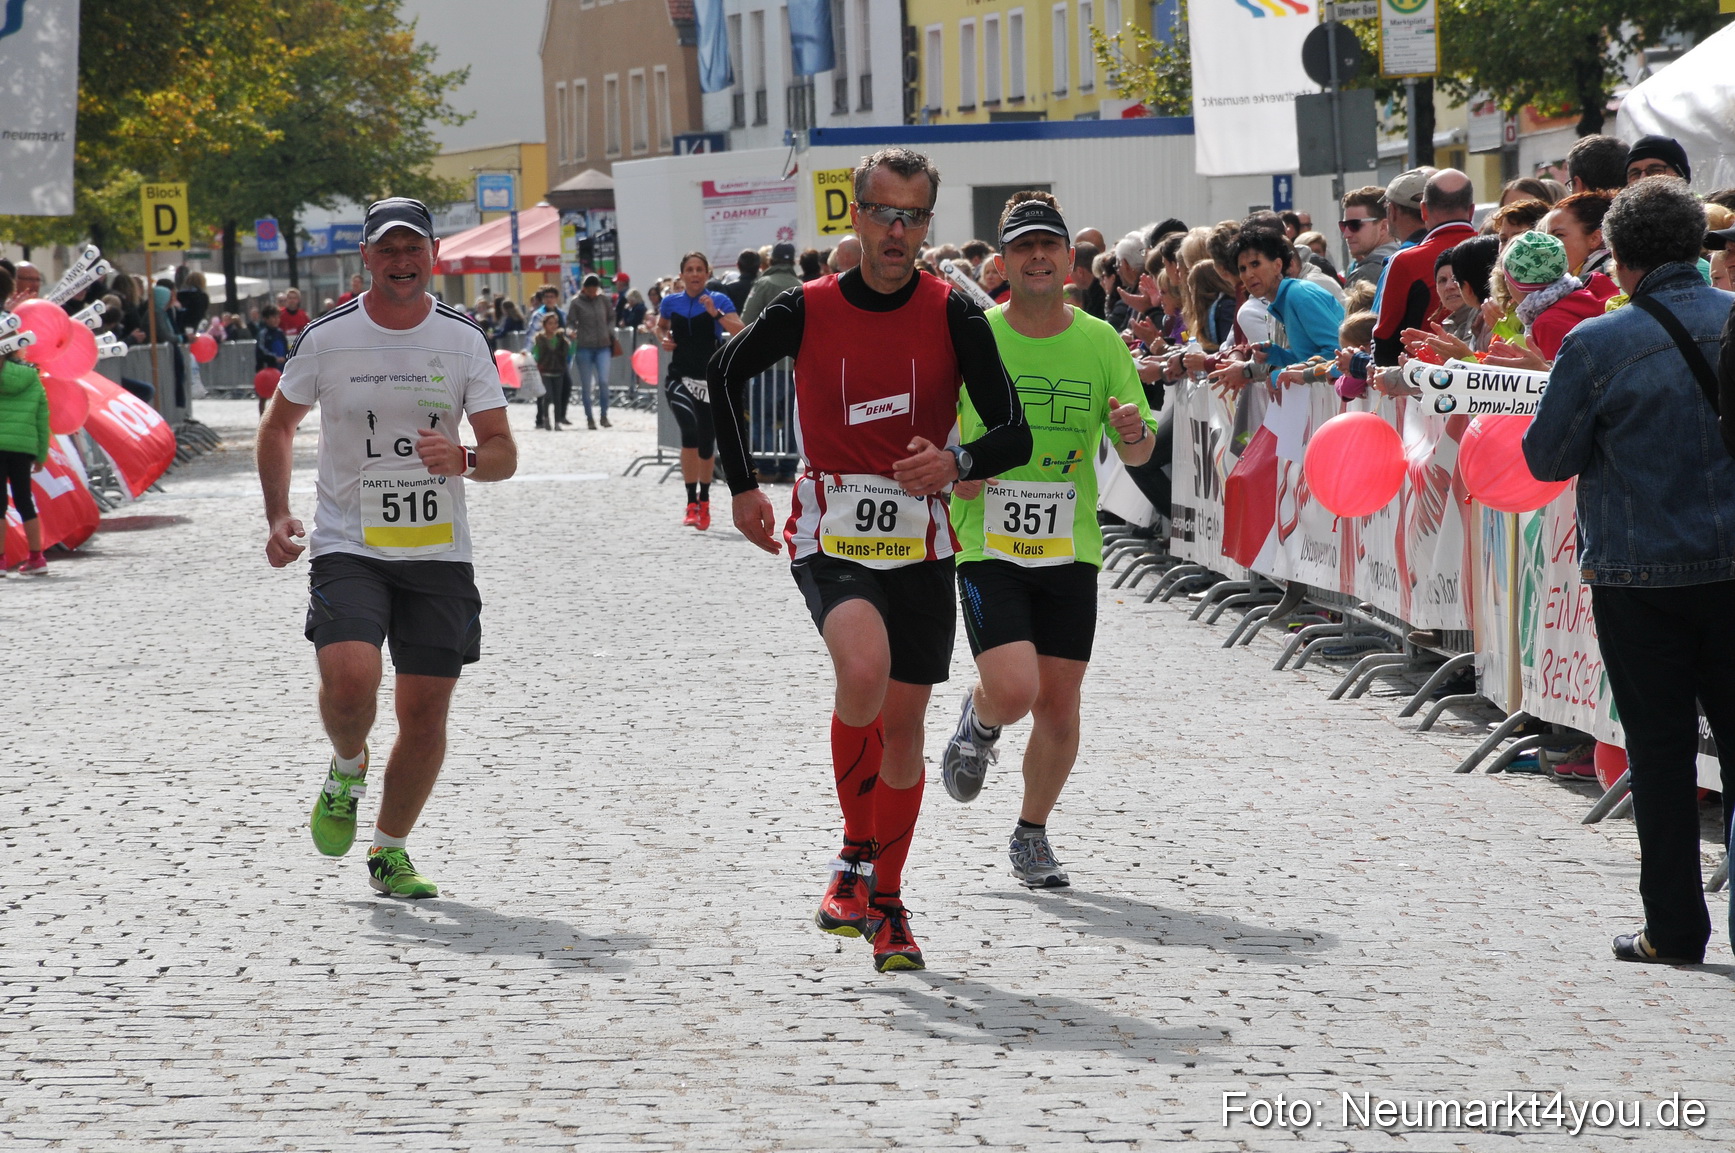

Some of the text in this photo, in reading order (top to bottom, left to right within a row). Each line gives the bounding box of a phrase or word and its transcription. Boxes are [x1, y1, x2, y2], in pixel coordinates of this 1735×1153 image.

[1337, 6, 1360, 17] Ulmer
[2, 130, 65, 142] neumarkt
[818, 171, 851, 185] Block
[146, 187, 182, 199] Block
[825, 189, 848, 221] D
[154, 204, 178, 236] D
[723, 207, 769, 220] DAHMIT
[350, 374, 387, 384] weidinger
[1466, 372, 1521, 393] BMW
[417, 399, 453, 410] Christian
[866, 402, 893, 416] DEHN
[366, 437, 413, 459] L G
[362, 477, 436, 488] PARTL Neumarkt
[827, 485, 861, 494] PARTL
[986, 486, 1063, 500] PARTL Neumarkt
[382, 489, 438, 523] 516
[855, 498, 899, 533] 98
[1003, 501, 1057, 535] 351
[836, 540, 911, 557] Hans-Peter
[1012, 541, 1044, 555] Klaus
